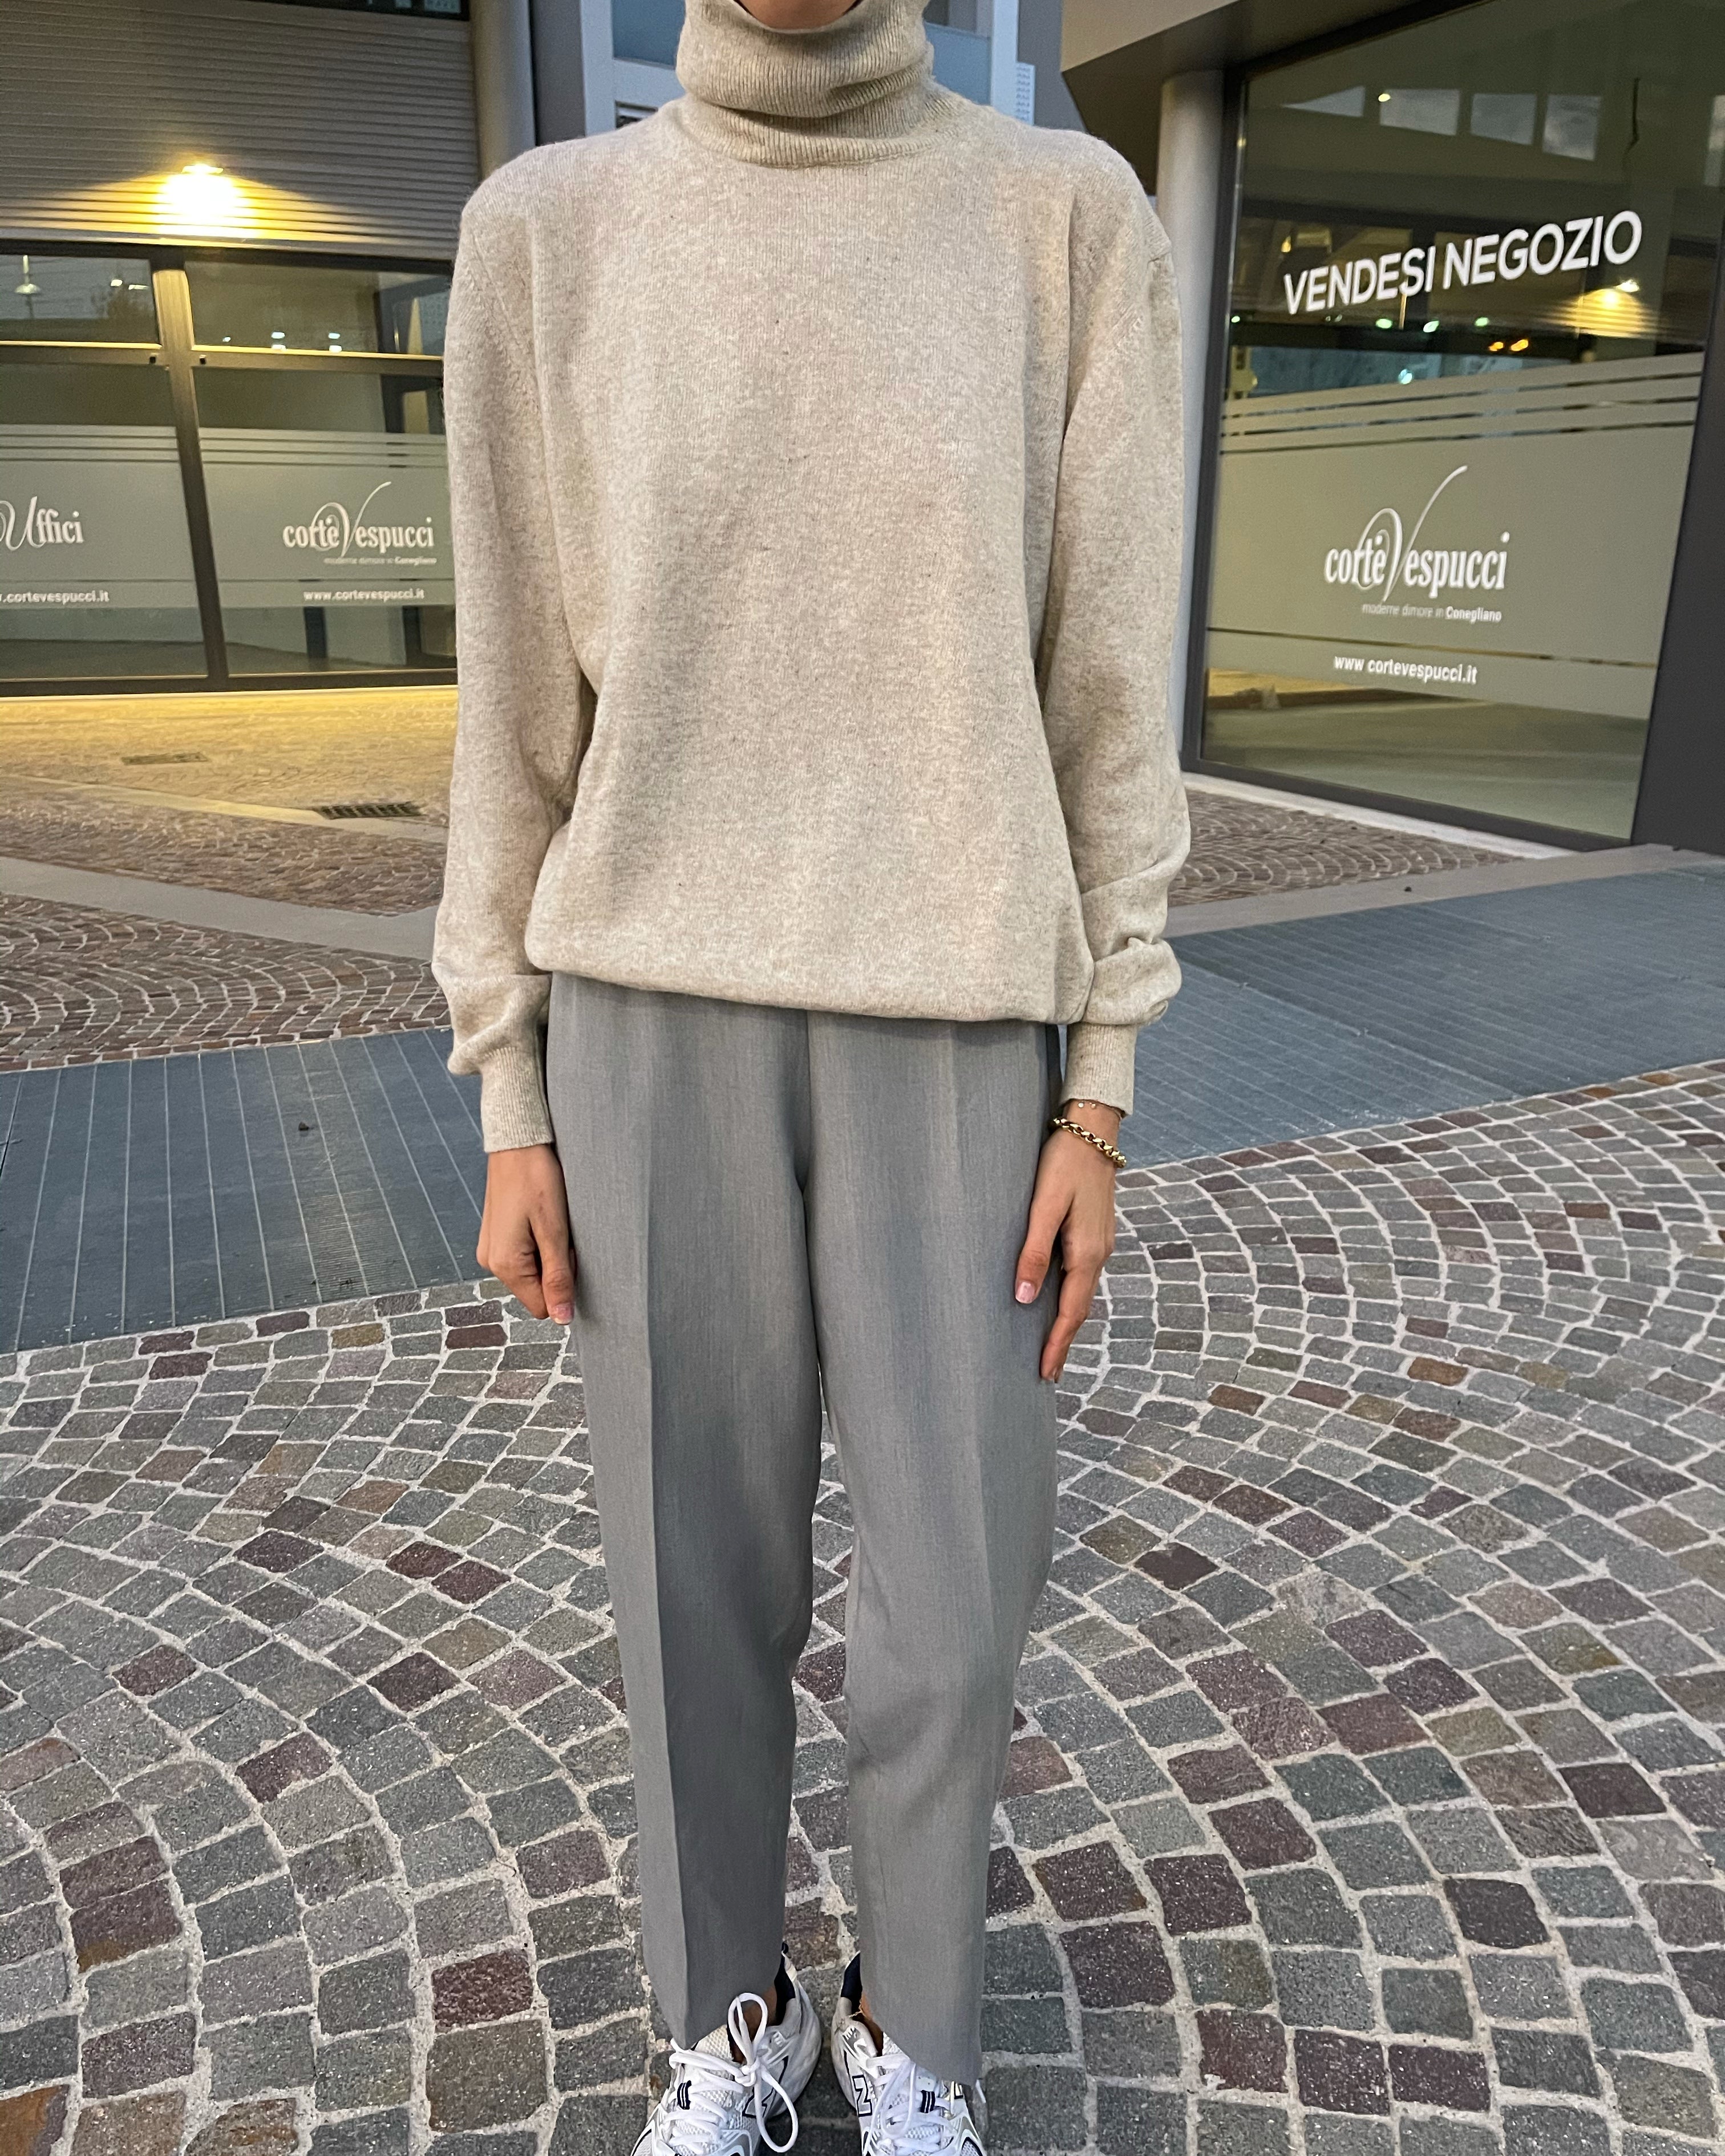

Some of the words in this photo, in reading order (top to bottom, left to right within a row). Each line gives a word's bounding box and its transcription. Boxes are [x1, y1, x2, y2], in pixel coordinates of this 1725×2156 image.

[1283, 245, 1436, 315] VENDESI
[1443, 210, 1643, 289] NEGOZIO
[303, 588, 425, 602] www.cortevespucci.it
[1445, 606, 1502, 624] Conegliano
